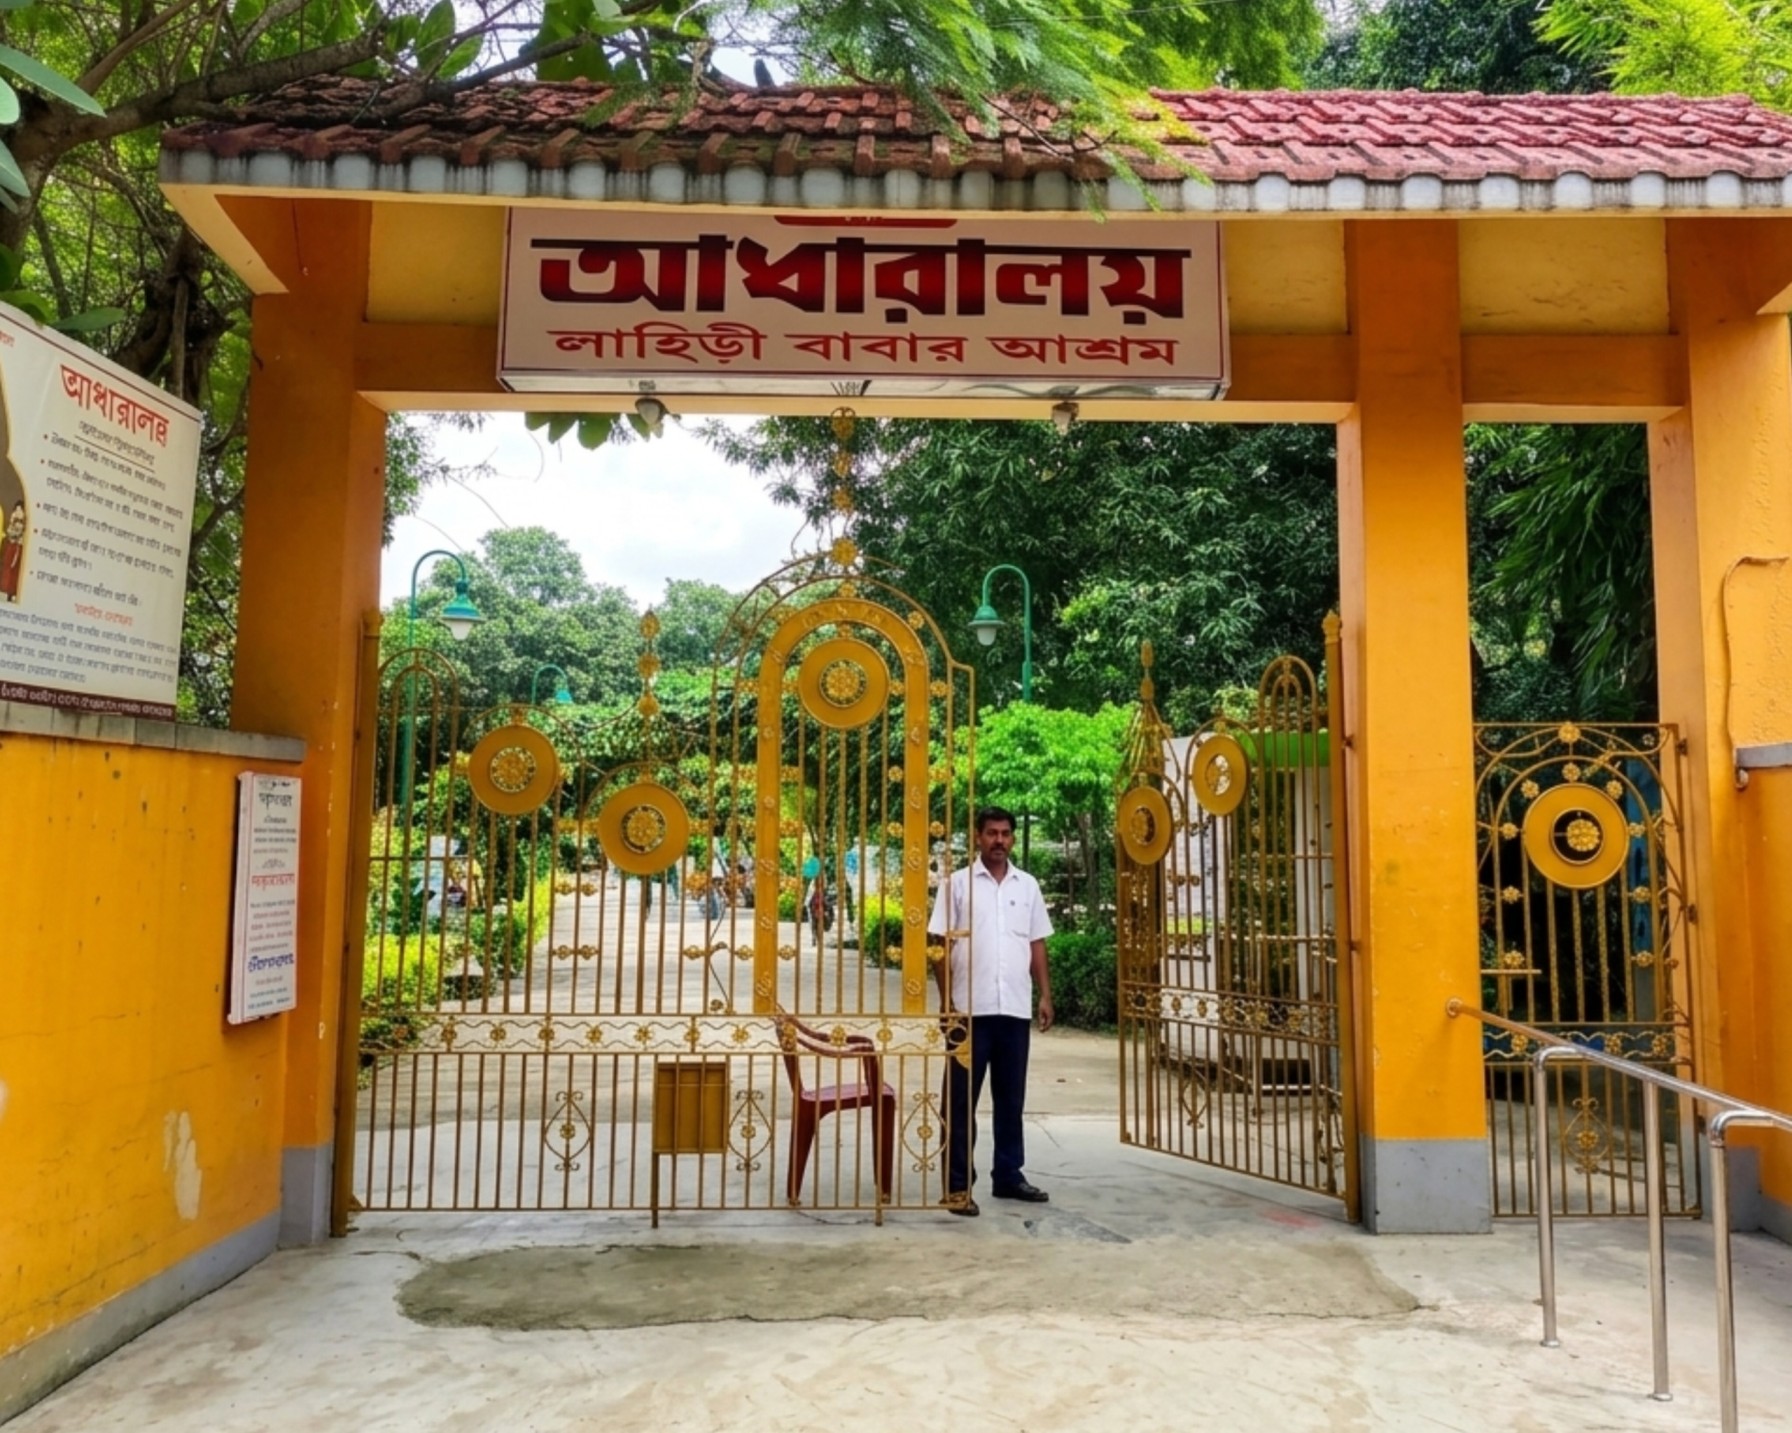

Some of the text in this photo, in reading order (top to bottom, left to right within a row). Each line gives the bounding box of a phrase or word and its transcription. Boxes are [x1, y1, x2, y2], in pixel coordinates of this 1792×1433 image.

[530, 234, 1192, 325] আধারালয়
[546, 320, 1180, 366] লাহিড়ী বাবার আশ্রম
